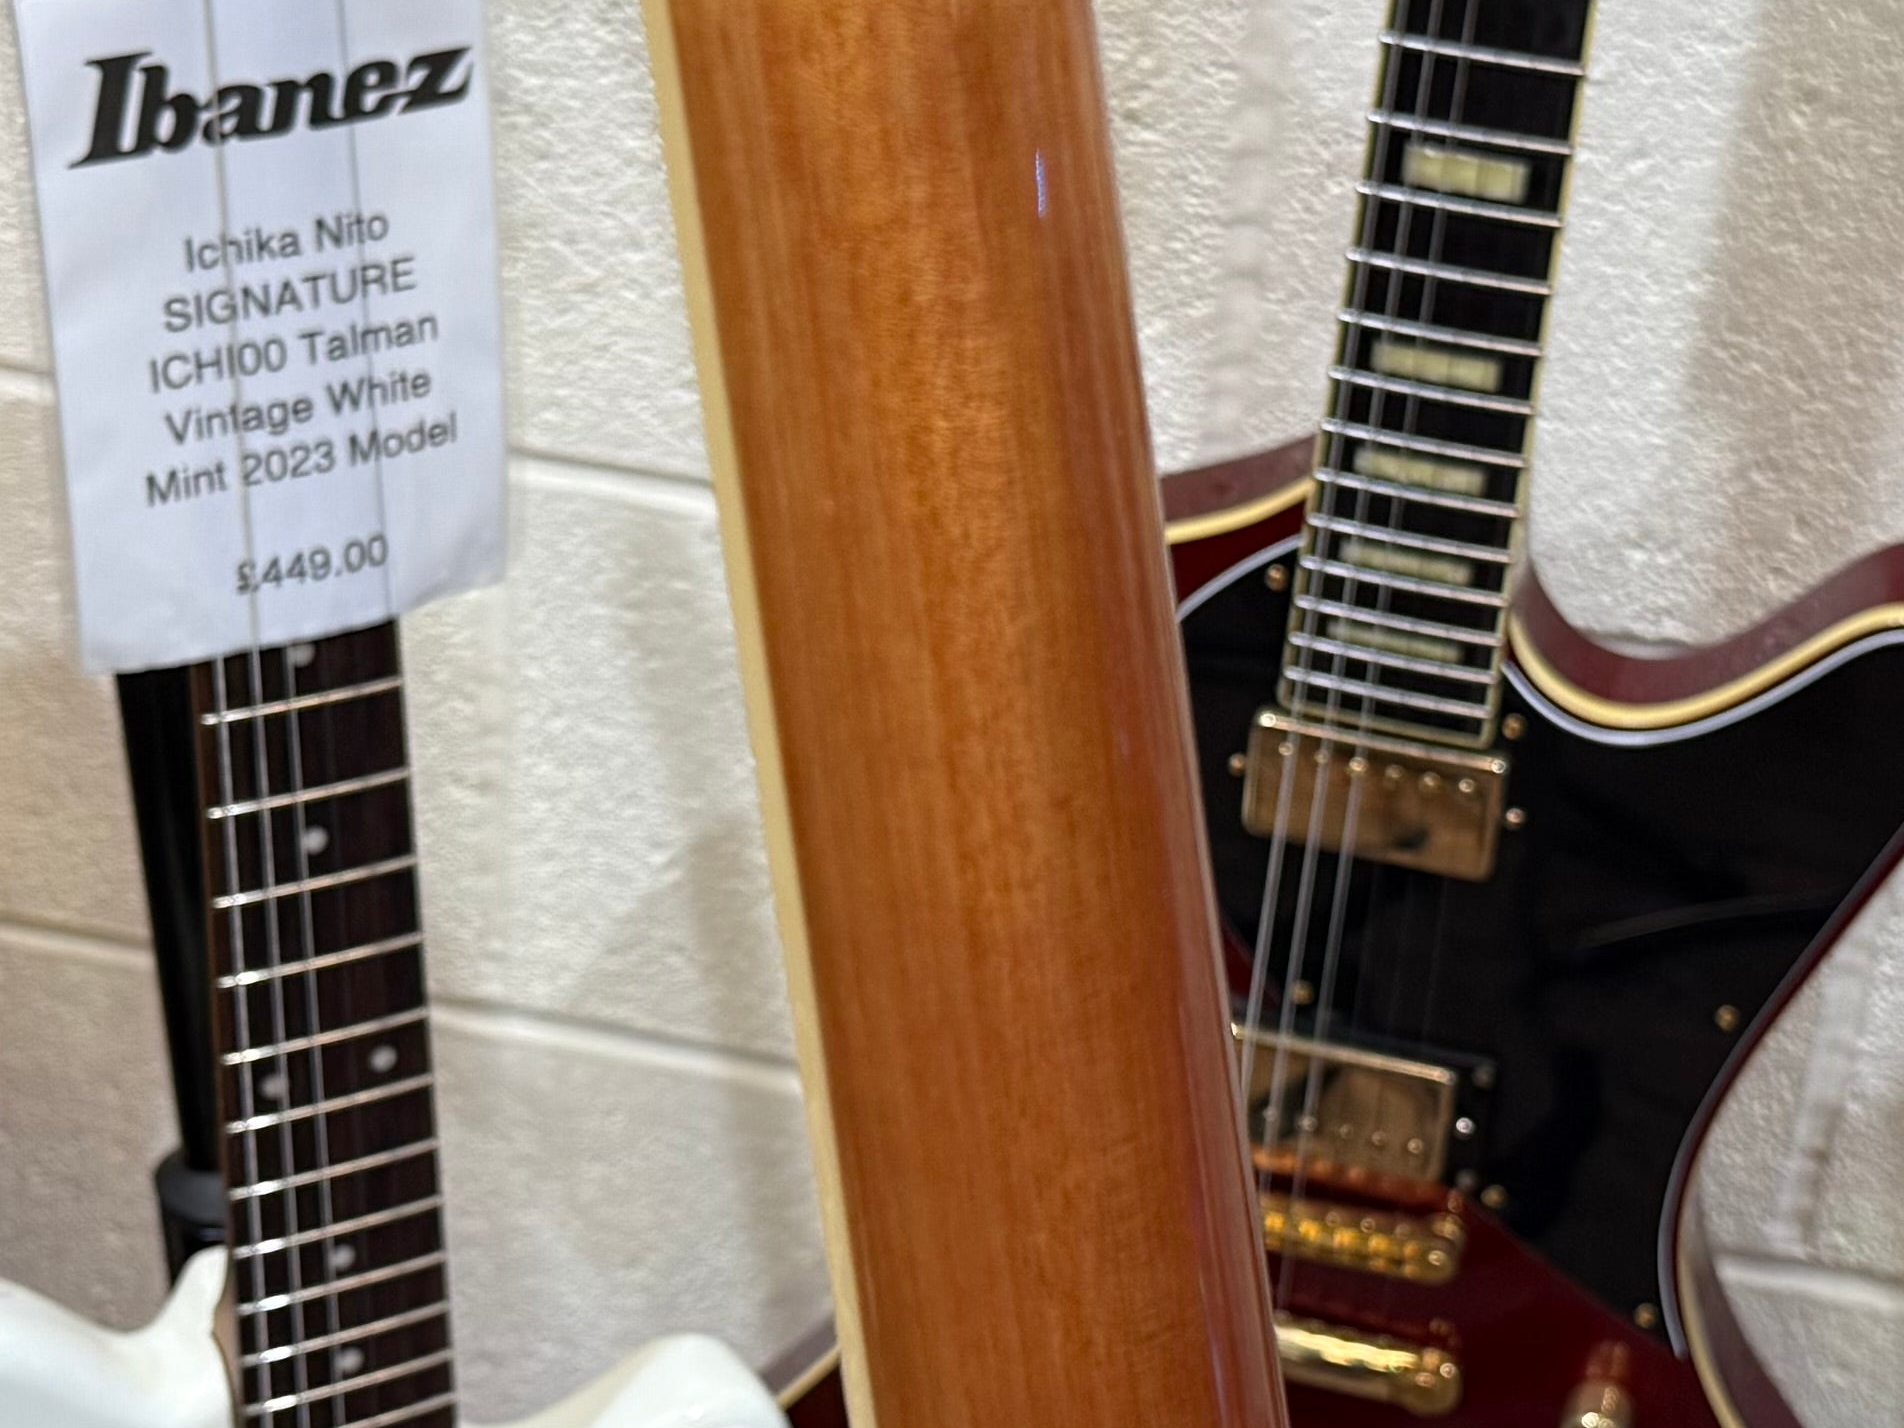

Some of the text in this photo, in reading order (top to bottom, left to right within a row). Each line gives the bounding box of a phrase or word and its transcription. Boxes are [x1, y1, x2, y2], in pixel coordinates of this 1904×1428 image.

[67, 46, 473, 170] Ibanez
[184, 210, 389, 273] Ichika Nito
[163, 256, 417, 333] SIGNATURE
[297, 315, 438, 367] Talman
[163, 369, 431, 447] Vintage White
[145, 413, 458, 507] Mint 2023 Model
[236, 533, 388, 594] £449.00
